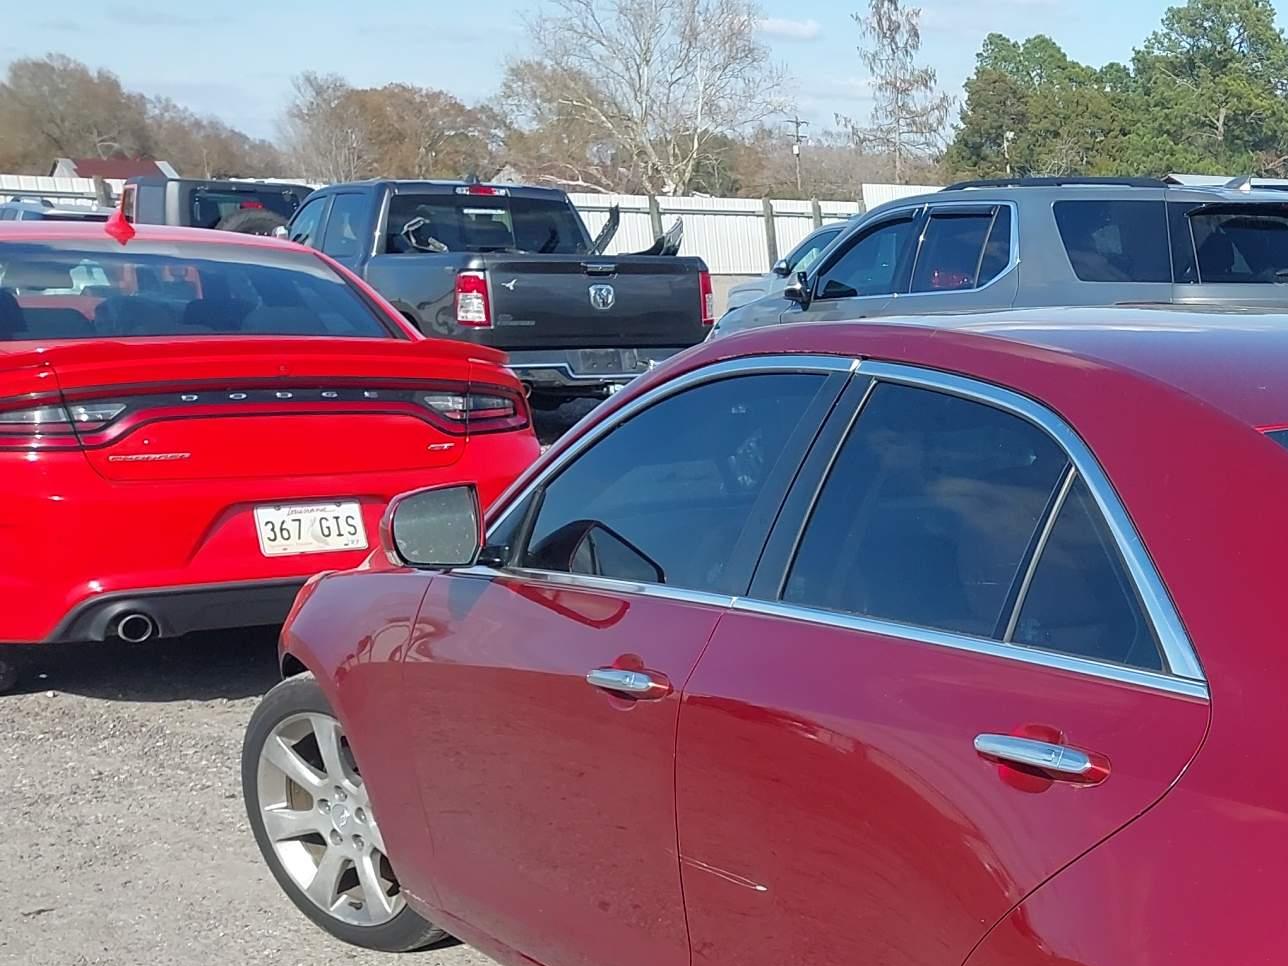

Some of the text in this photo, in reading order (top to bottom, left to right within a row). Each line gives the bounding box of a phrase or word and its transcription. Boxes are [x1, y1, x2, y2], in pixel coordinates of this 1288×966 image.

[181, 390, 379, 402] DODGE
[264, 515, 358, 542] 367 GIS
